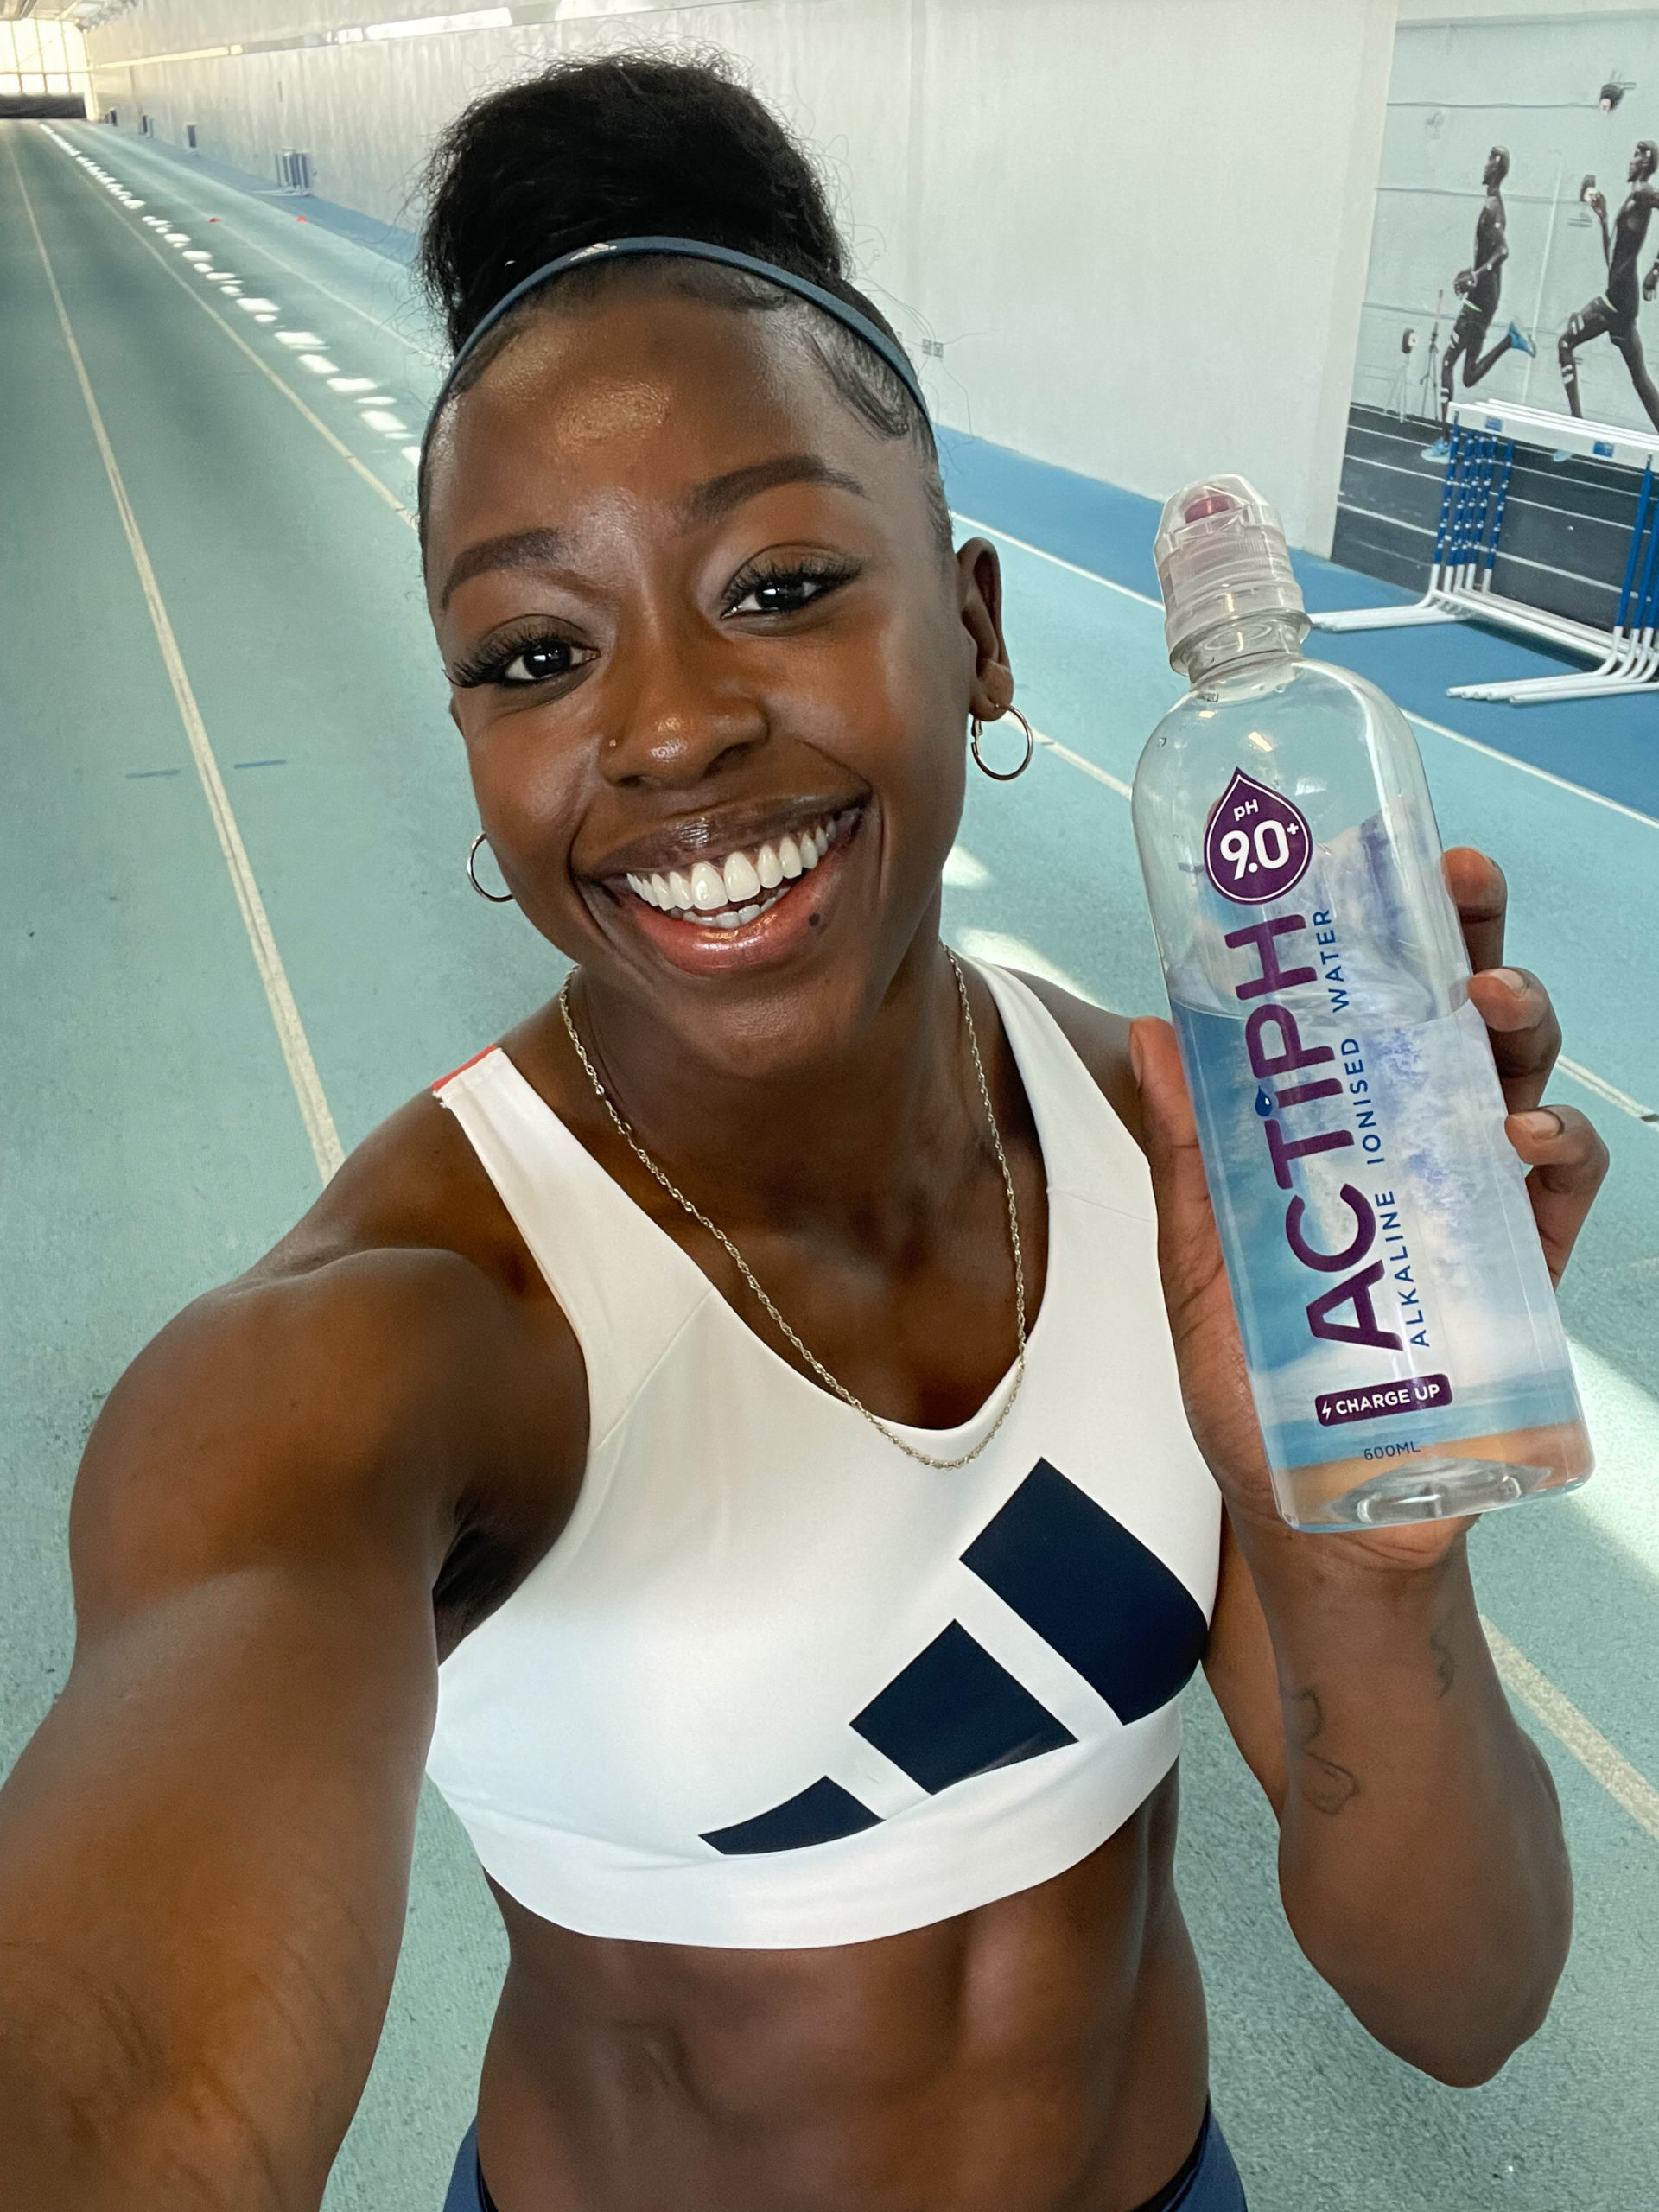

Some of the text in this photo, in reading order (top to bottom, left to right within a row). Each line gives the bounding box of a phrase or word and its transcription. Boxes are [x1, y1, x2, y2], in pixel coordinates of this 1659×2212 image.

[1233, 798, 1260, 822] pH
[1313, 909, 1430, 1348] ALKALINE IONISED WATER
[1335, 1383, 1440, 1415] CHARGE UP
[1363, 1440, 1421, 1461] 600ML
